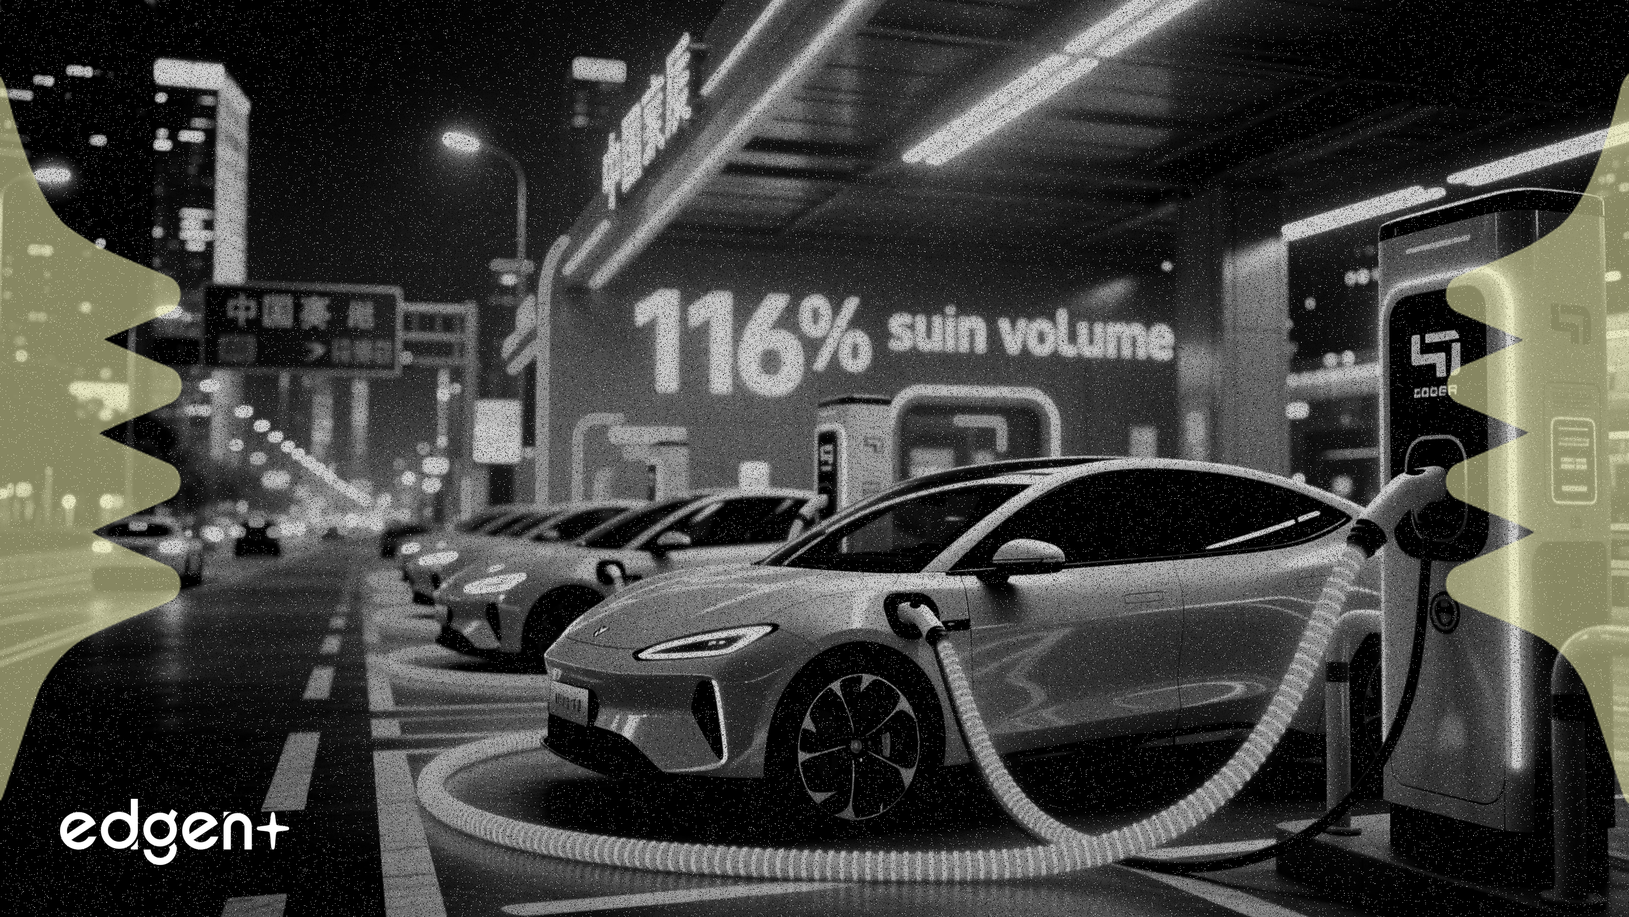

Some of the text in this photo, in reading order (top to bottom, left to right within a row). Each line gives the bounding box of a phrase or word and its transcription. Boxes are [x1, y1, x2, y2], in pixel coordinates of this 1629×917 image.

[634, 288, 1175, 397] 116% suin volume
